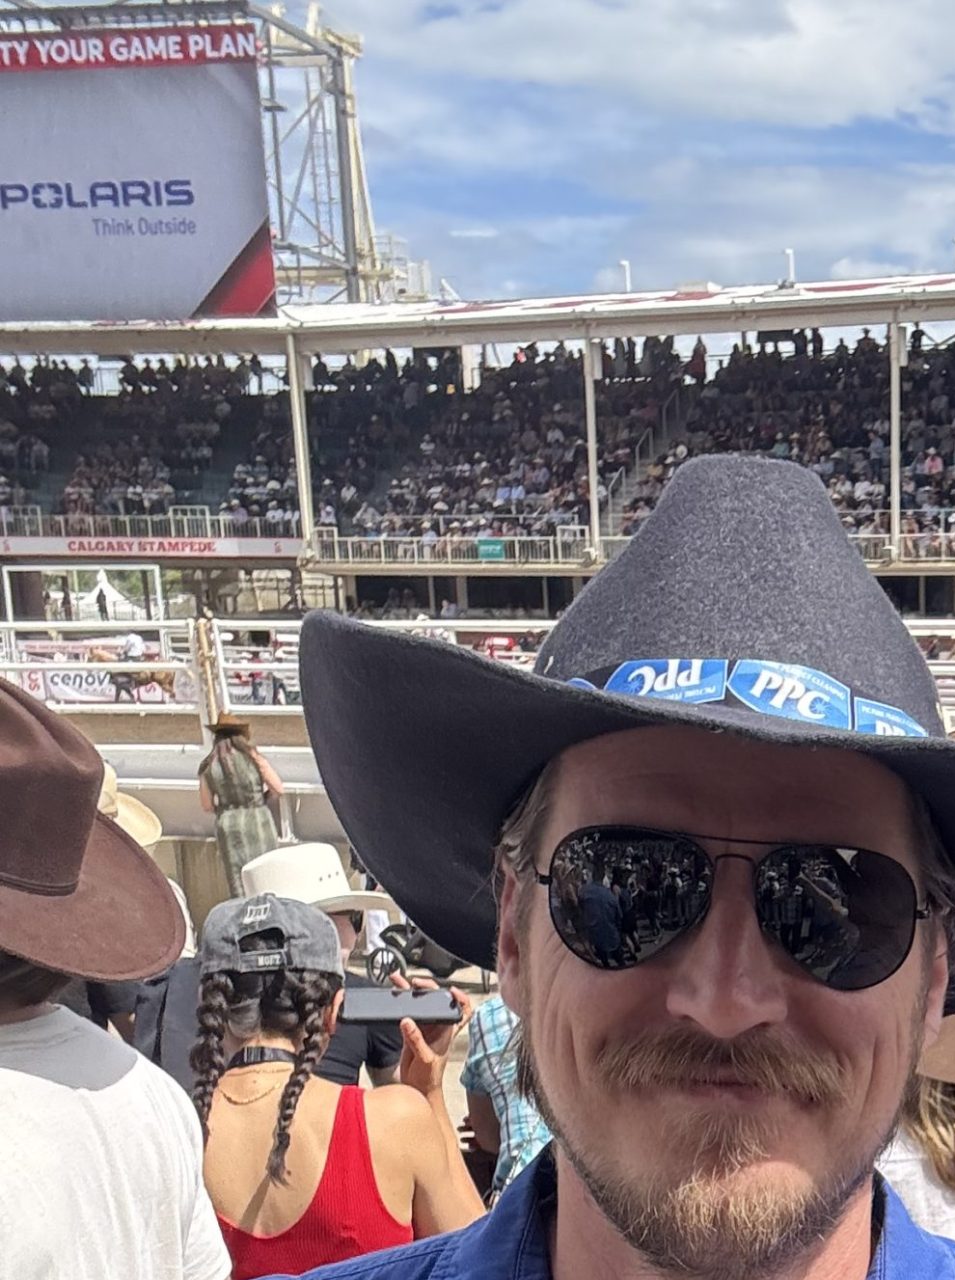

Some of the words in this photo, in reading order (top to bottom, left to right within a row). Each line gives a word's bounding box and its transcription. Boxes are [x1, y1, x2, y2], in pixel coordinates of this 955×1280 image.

[33, 39, 105, 65] YOUR
[109, 35, 184, 62] GAME
[188, 33, 256, 60] PLAN
[0, 179, 195, 210] POLARIS
[92, 218, 135, 236] Think
[138, 217, 197, 236] Outside
[67, 540, 134, 552] CALGARY
[137, 540, 216, 552] STAMPEDE
[749, 669, 831, 720] PPC
